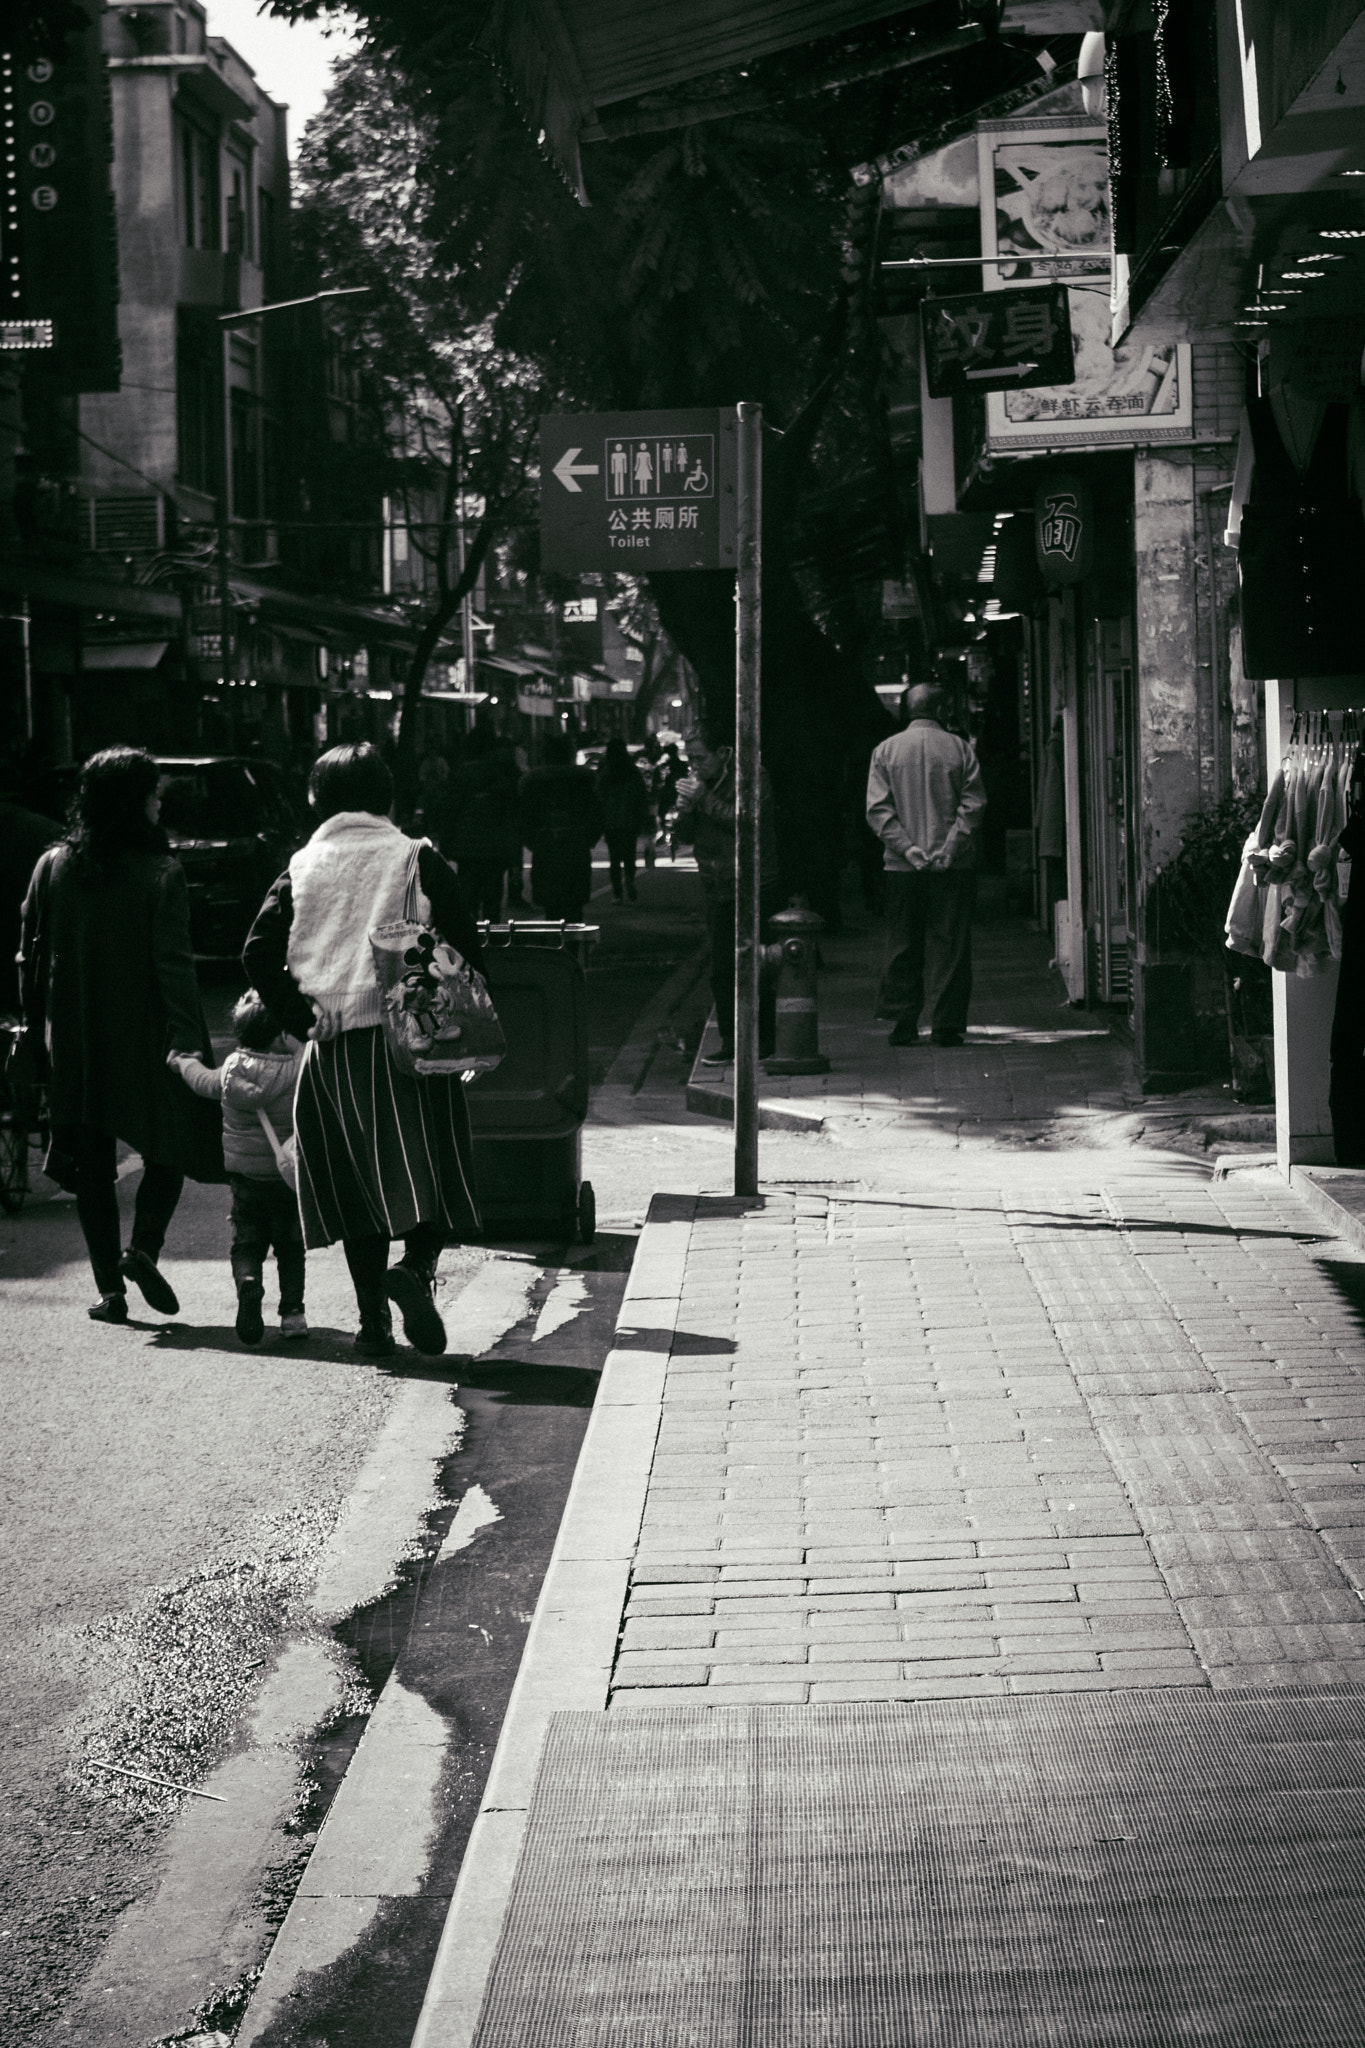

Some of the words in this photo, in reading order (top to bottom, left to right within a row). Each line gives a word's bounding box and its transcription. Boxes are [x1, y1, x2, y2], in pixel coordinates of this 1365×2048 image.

[1040, 395, 1145, 414] 鲜虾云吞面
[608, 505, 700, 531] 公共厕所
[608, 534, 651, 548] Toilet
